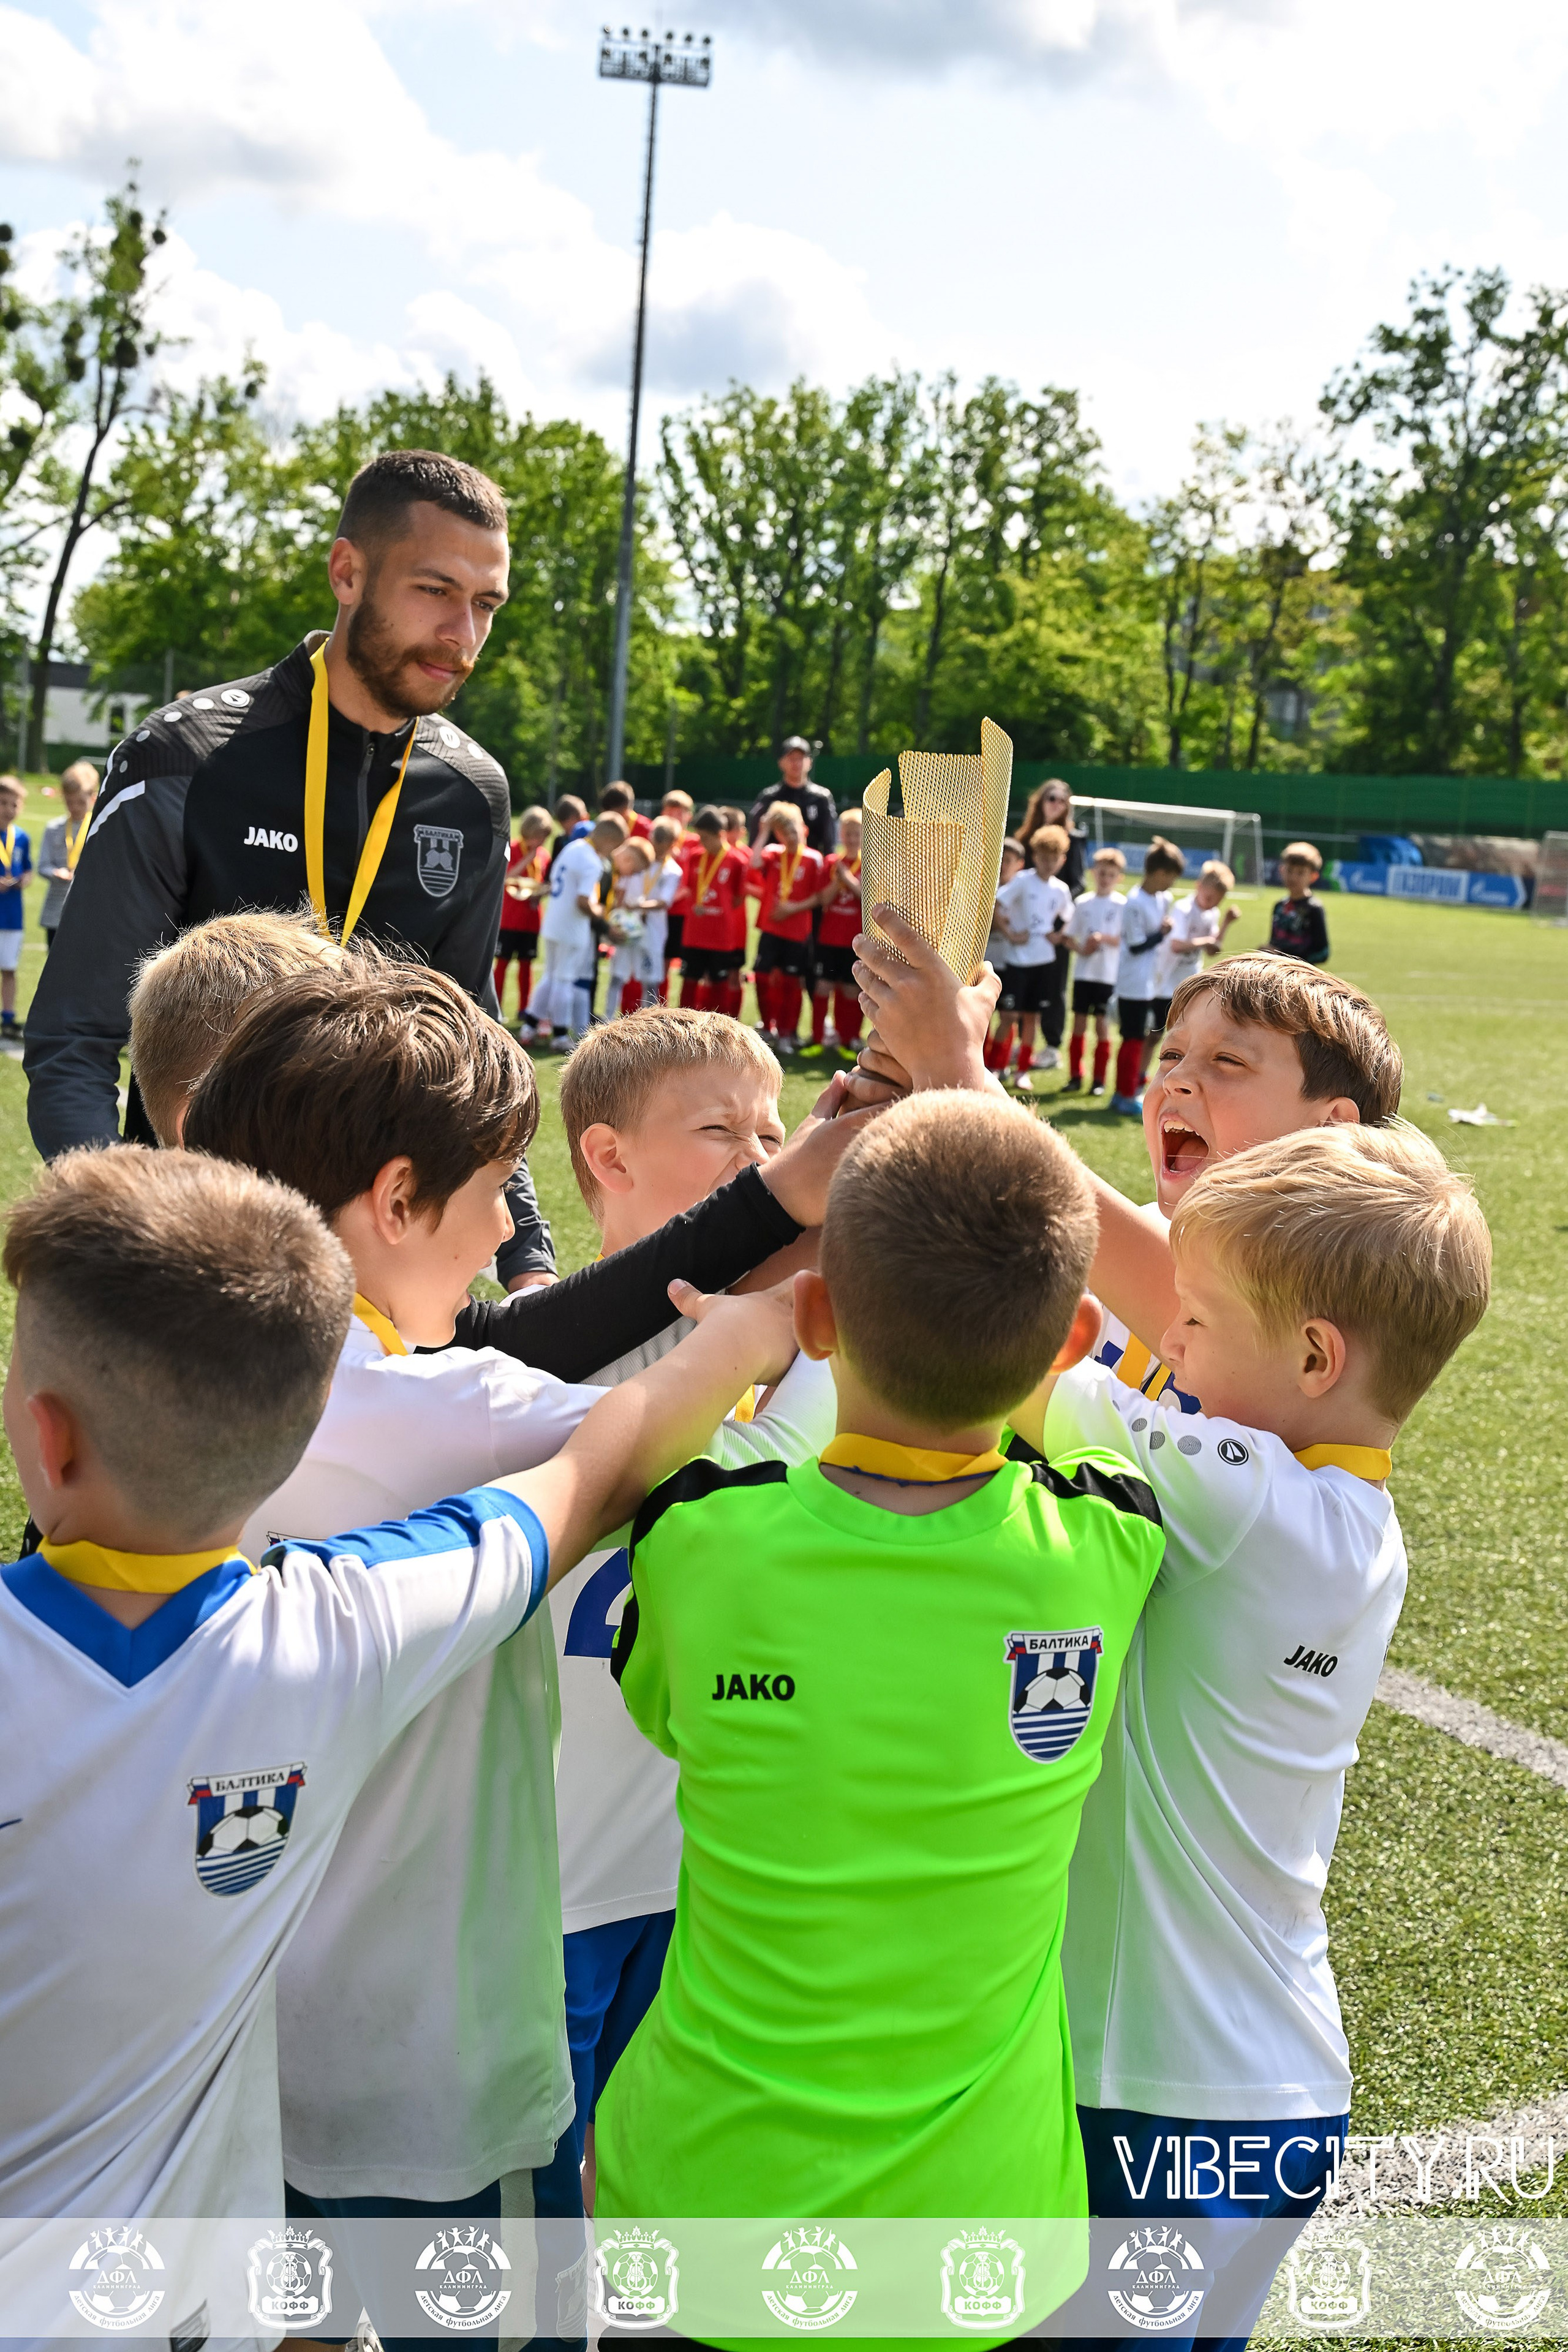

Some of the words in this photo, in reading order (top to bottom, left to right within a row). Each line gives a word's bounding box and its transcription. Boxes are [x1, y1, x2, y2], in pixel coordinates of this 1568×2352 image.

[244, 826, 298, 853] JAKO
[1030, 1635, 1088, 1649] БАЛТИКА
[1283, 1645, 1338, 1677] JAKO
[712, 1674, 795, 1701] JAKO
[216, 1772, 285, 1792] БАЛТИКА
